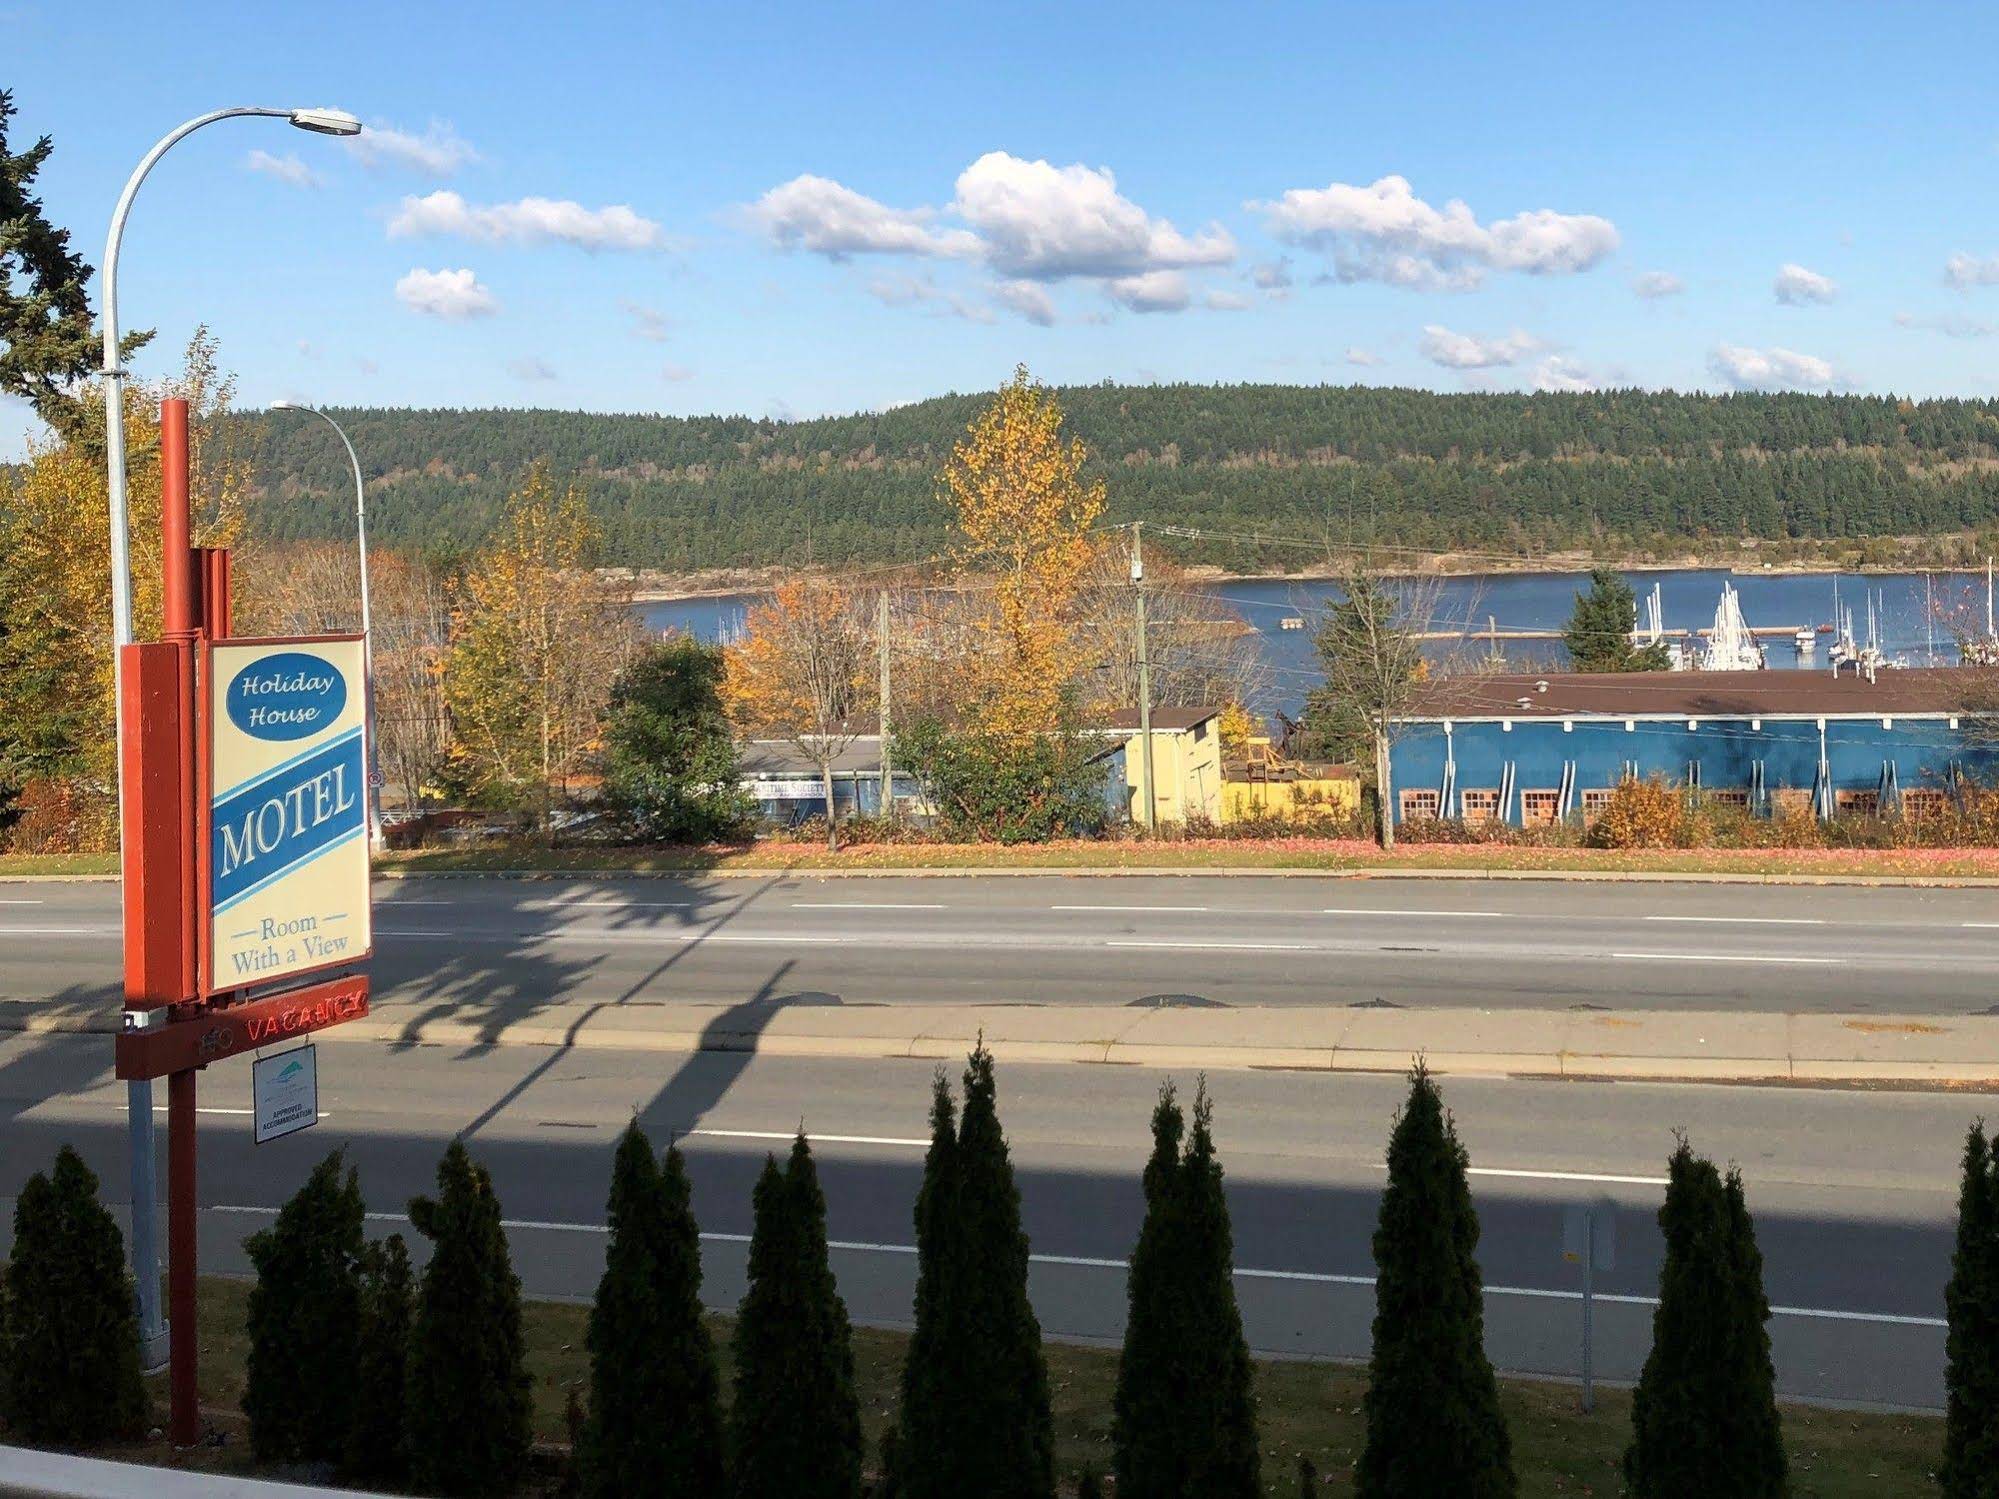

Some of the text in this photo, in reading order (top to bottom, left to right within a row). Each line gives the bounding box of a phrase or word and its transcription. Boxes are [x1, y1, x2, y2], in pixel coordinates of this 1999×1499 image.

[242, 672, 335, 697] Holiday
[249, 706, 322, 727] House
[220, 763, 355, 878] MOTEL
[260, 915, 317, 941] Room
[231, 935, 349, 976] With a View
[247, 990, 365, 1041] VACANCY
